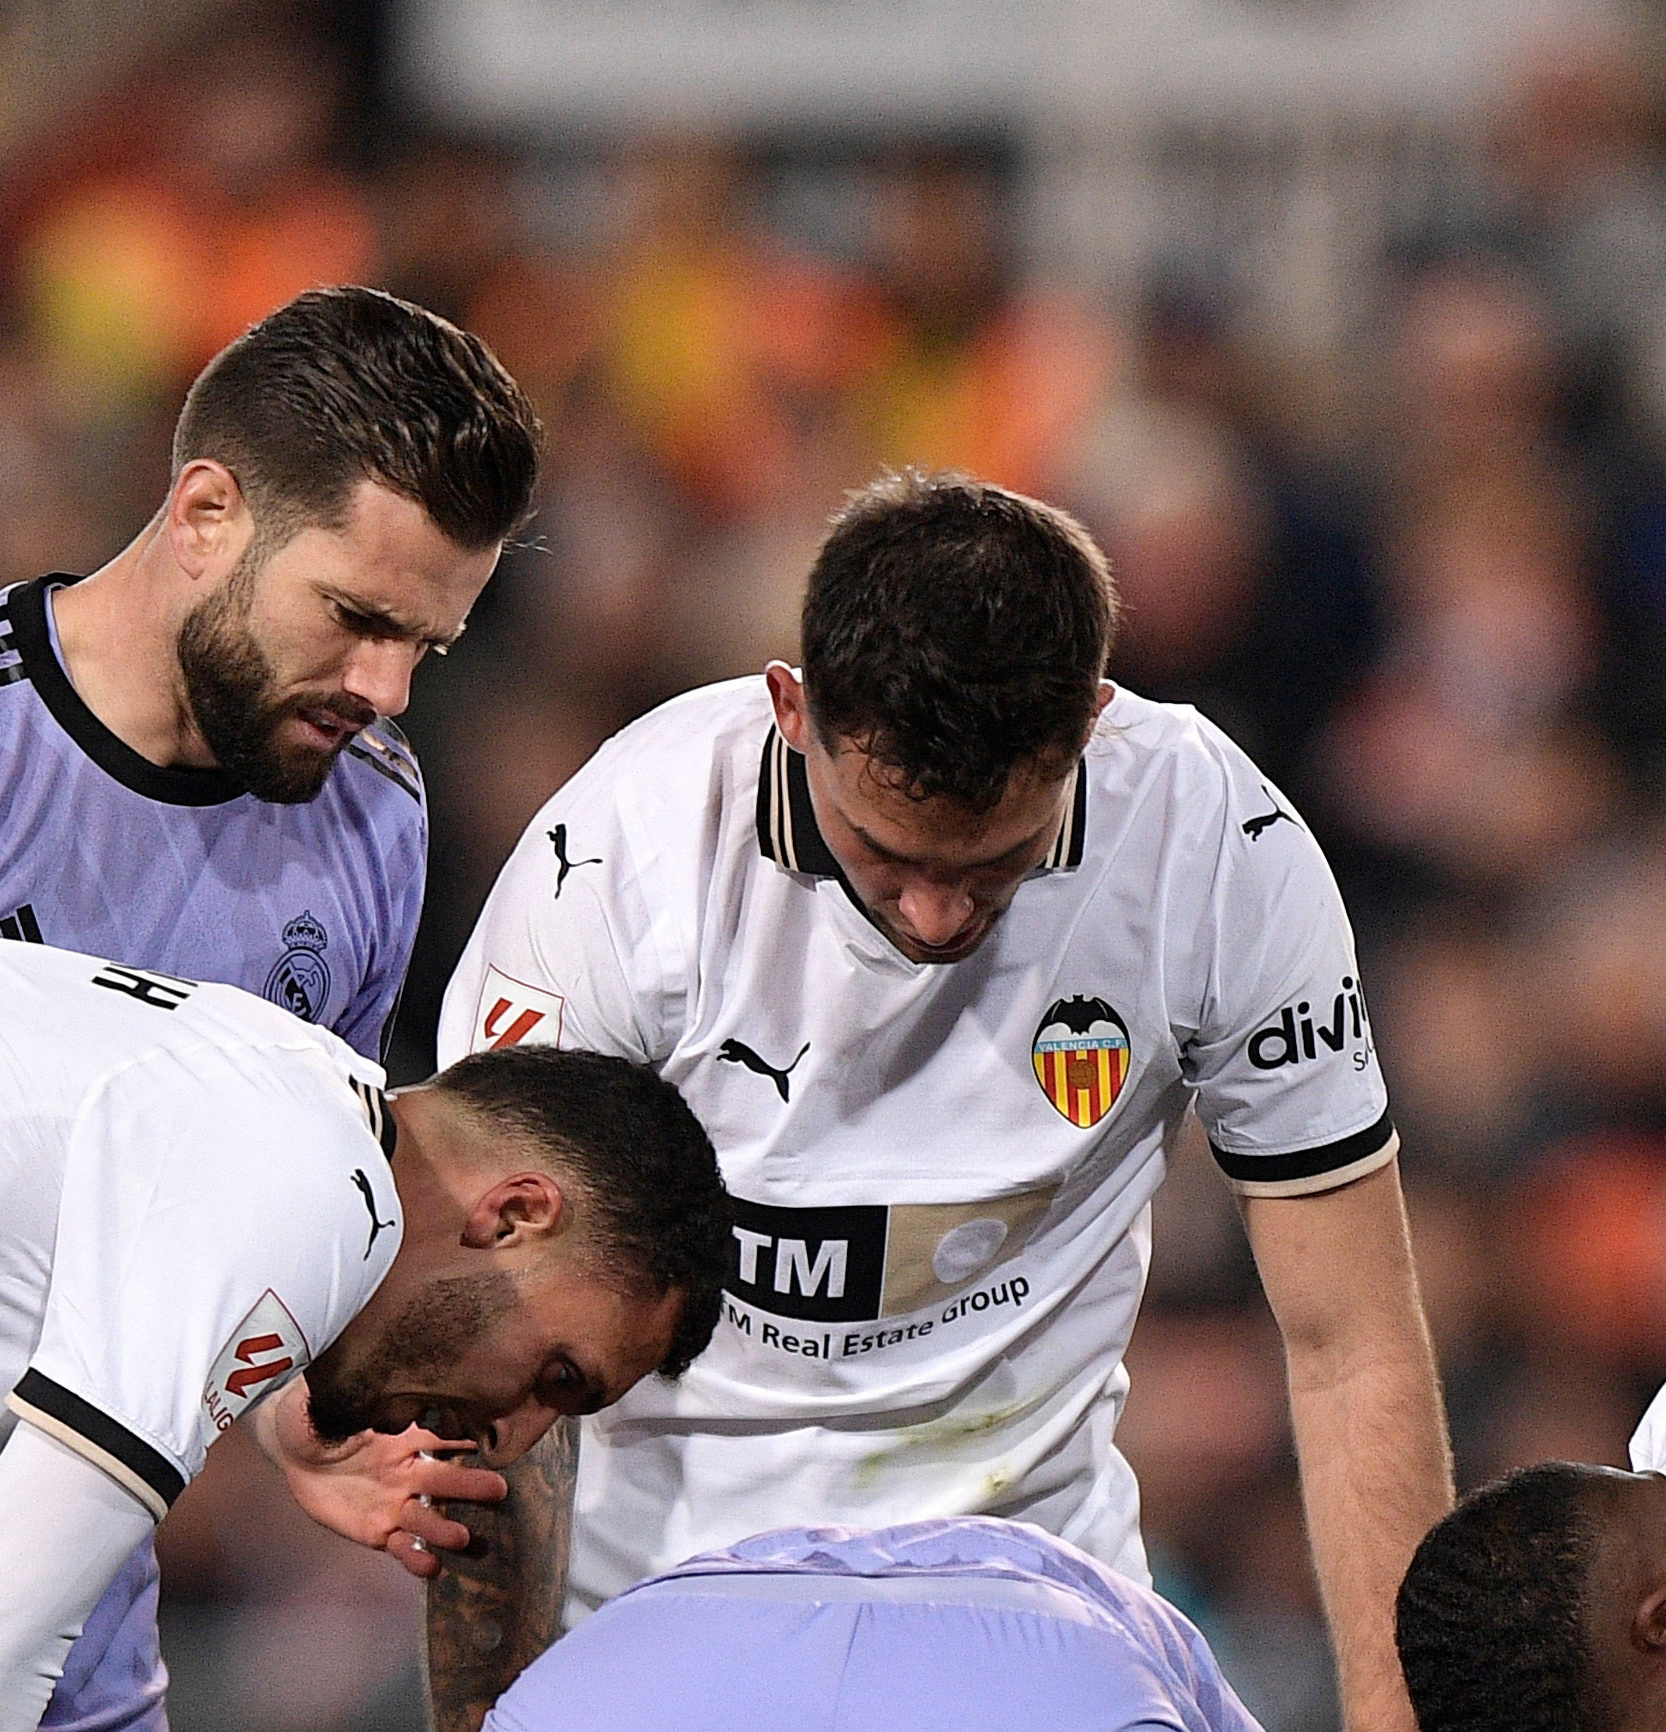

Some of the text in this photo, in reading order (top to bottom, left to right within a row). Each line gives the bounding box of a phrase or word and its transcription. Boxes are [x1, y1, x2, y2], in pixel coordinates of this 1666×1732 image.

[1038, 1040, 1099, 1052] VALENCIA
[1247, 975, 1367, 1071] divi
[732, 1225, 849, 1298] TM
[762, 1323, 831, 1360] Real
[842, 1319, 934, 1357] Estate
[941, 1275, 1031, 1325] Group
